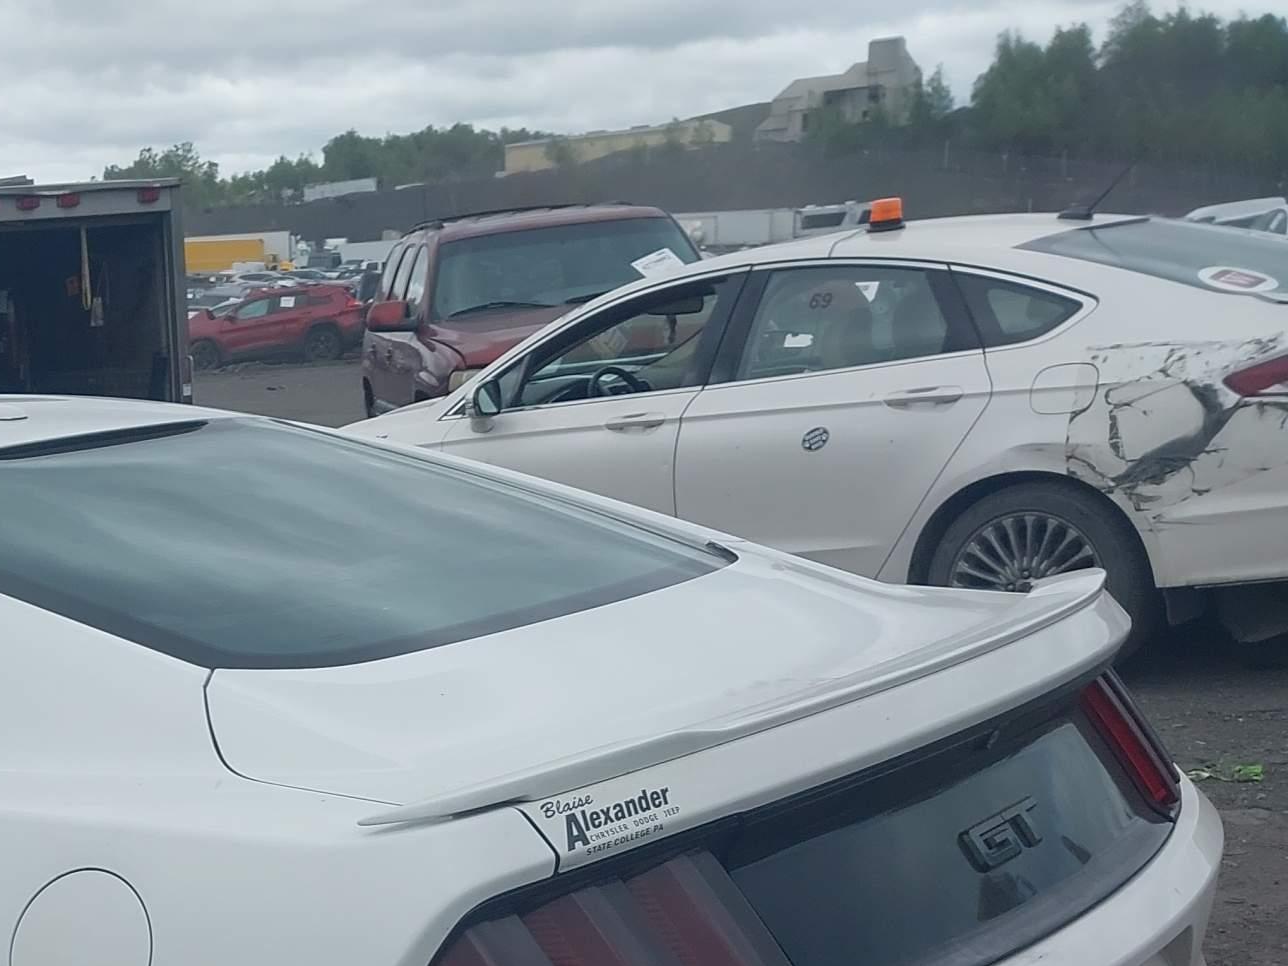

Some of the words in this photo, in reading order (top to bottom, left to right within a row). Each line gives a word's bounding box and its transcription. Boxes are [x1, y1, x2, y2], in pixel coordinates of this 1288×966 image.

[540, 794, 594, 819] Blaise
[566, 786, 670, 852] Alexander
[590, 823, 630, 842] CHRYSLER
[633, 813, 659, 827] DODGE
[664, 806, 681, 819] JEEP
[586, 840, 613, 856] STATE
[613, 829, 651, 847] COLLEGE
[653, 823, 665, 833] PA
[957, 794, 1043, 873] GT
